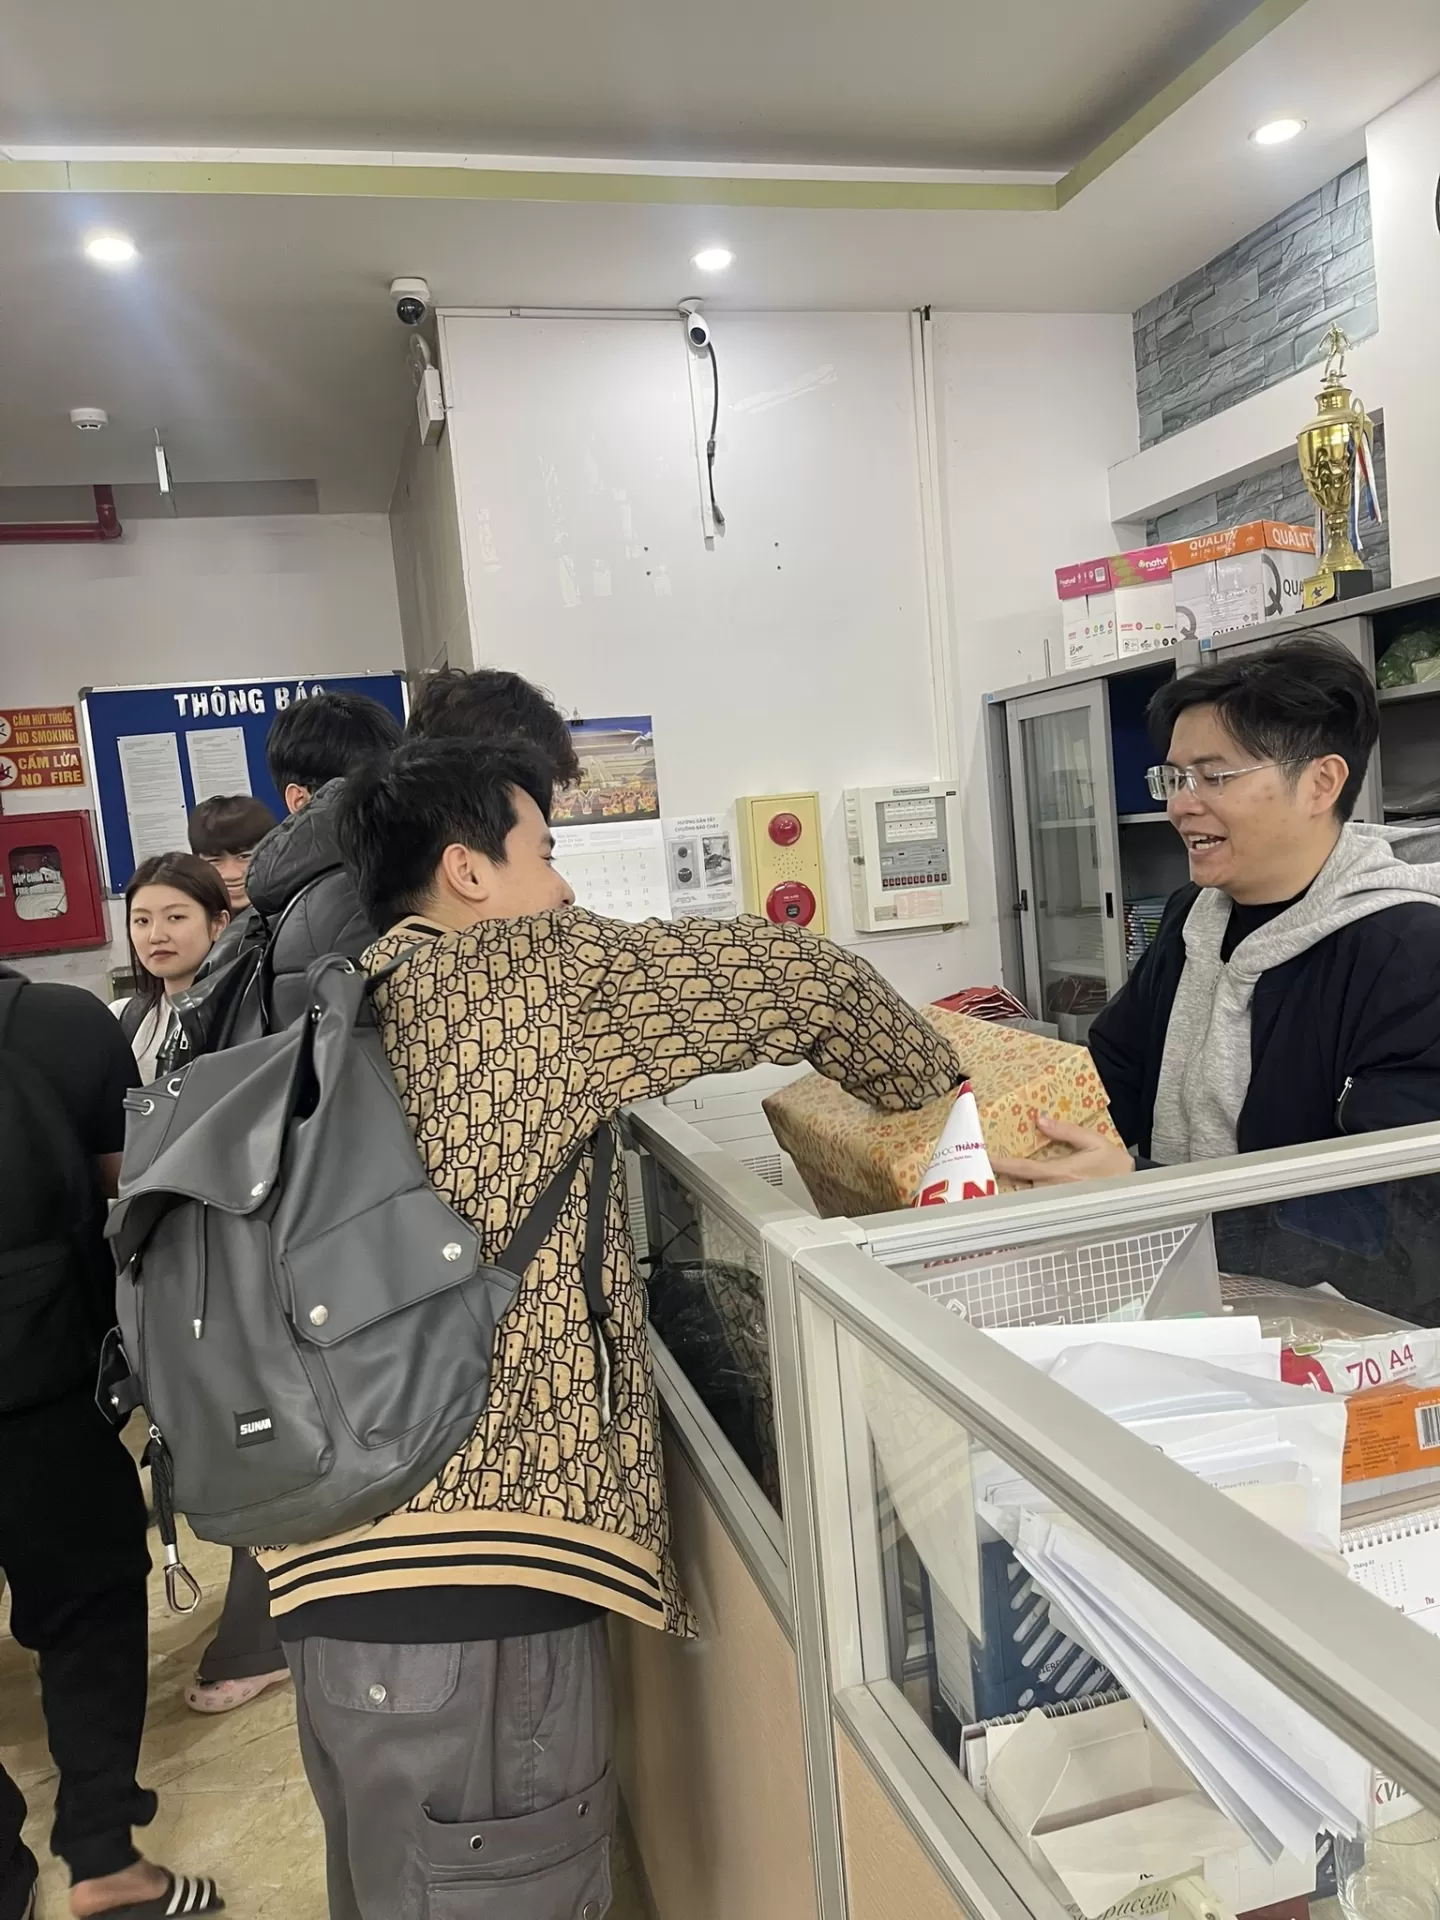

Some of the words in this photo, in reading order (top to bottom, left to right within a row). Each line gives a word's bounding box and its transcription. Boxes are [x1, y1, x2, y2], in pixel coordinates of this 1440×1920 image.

[1189, 529, 1238, 551] QUALITY
[173, 685, 266, 719] THÔNG
[32, 710, 47, 726] HÚT
[48, 708, 73, 724] THUỐC
[15, 731, 29, 744] NO
[31, 728, 75, 744] SMOKING
[18, 752, 50, 770] CẤM
[21, 773, 43, 786] NO
[50, 769, 82, 785] FIRE
[1345, 1357, 1382, 1391] 70
[1389, 1343, 1414, 1370] A4
